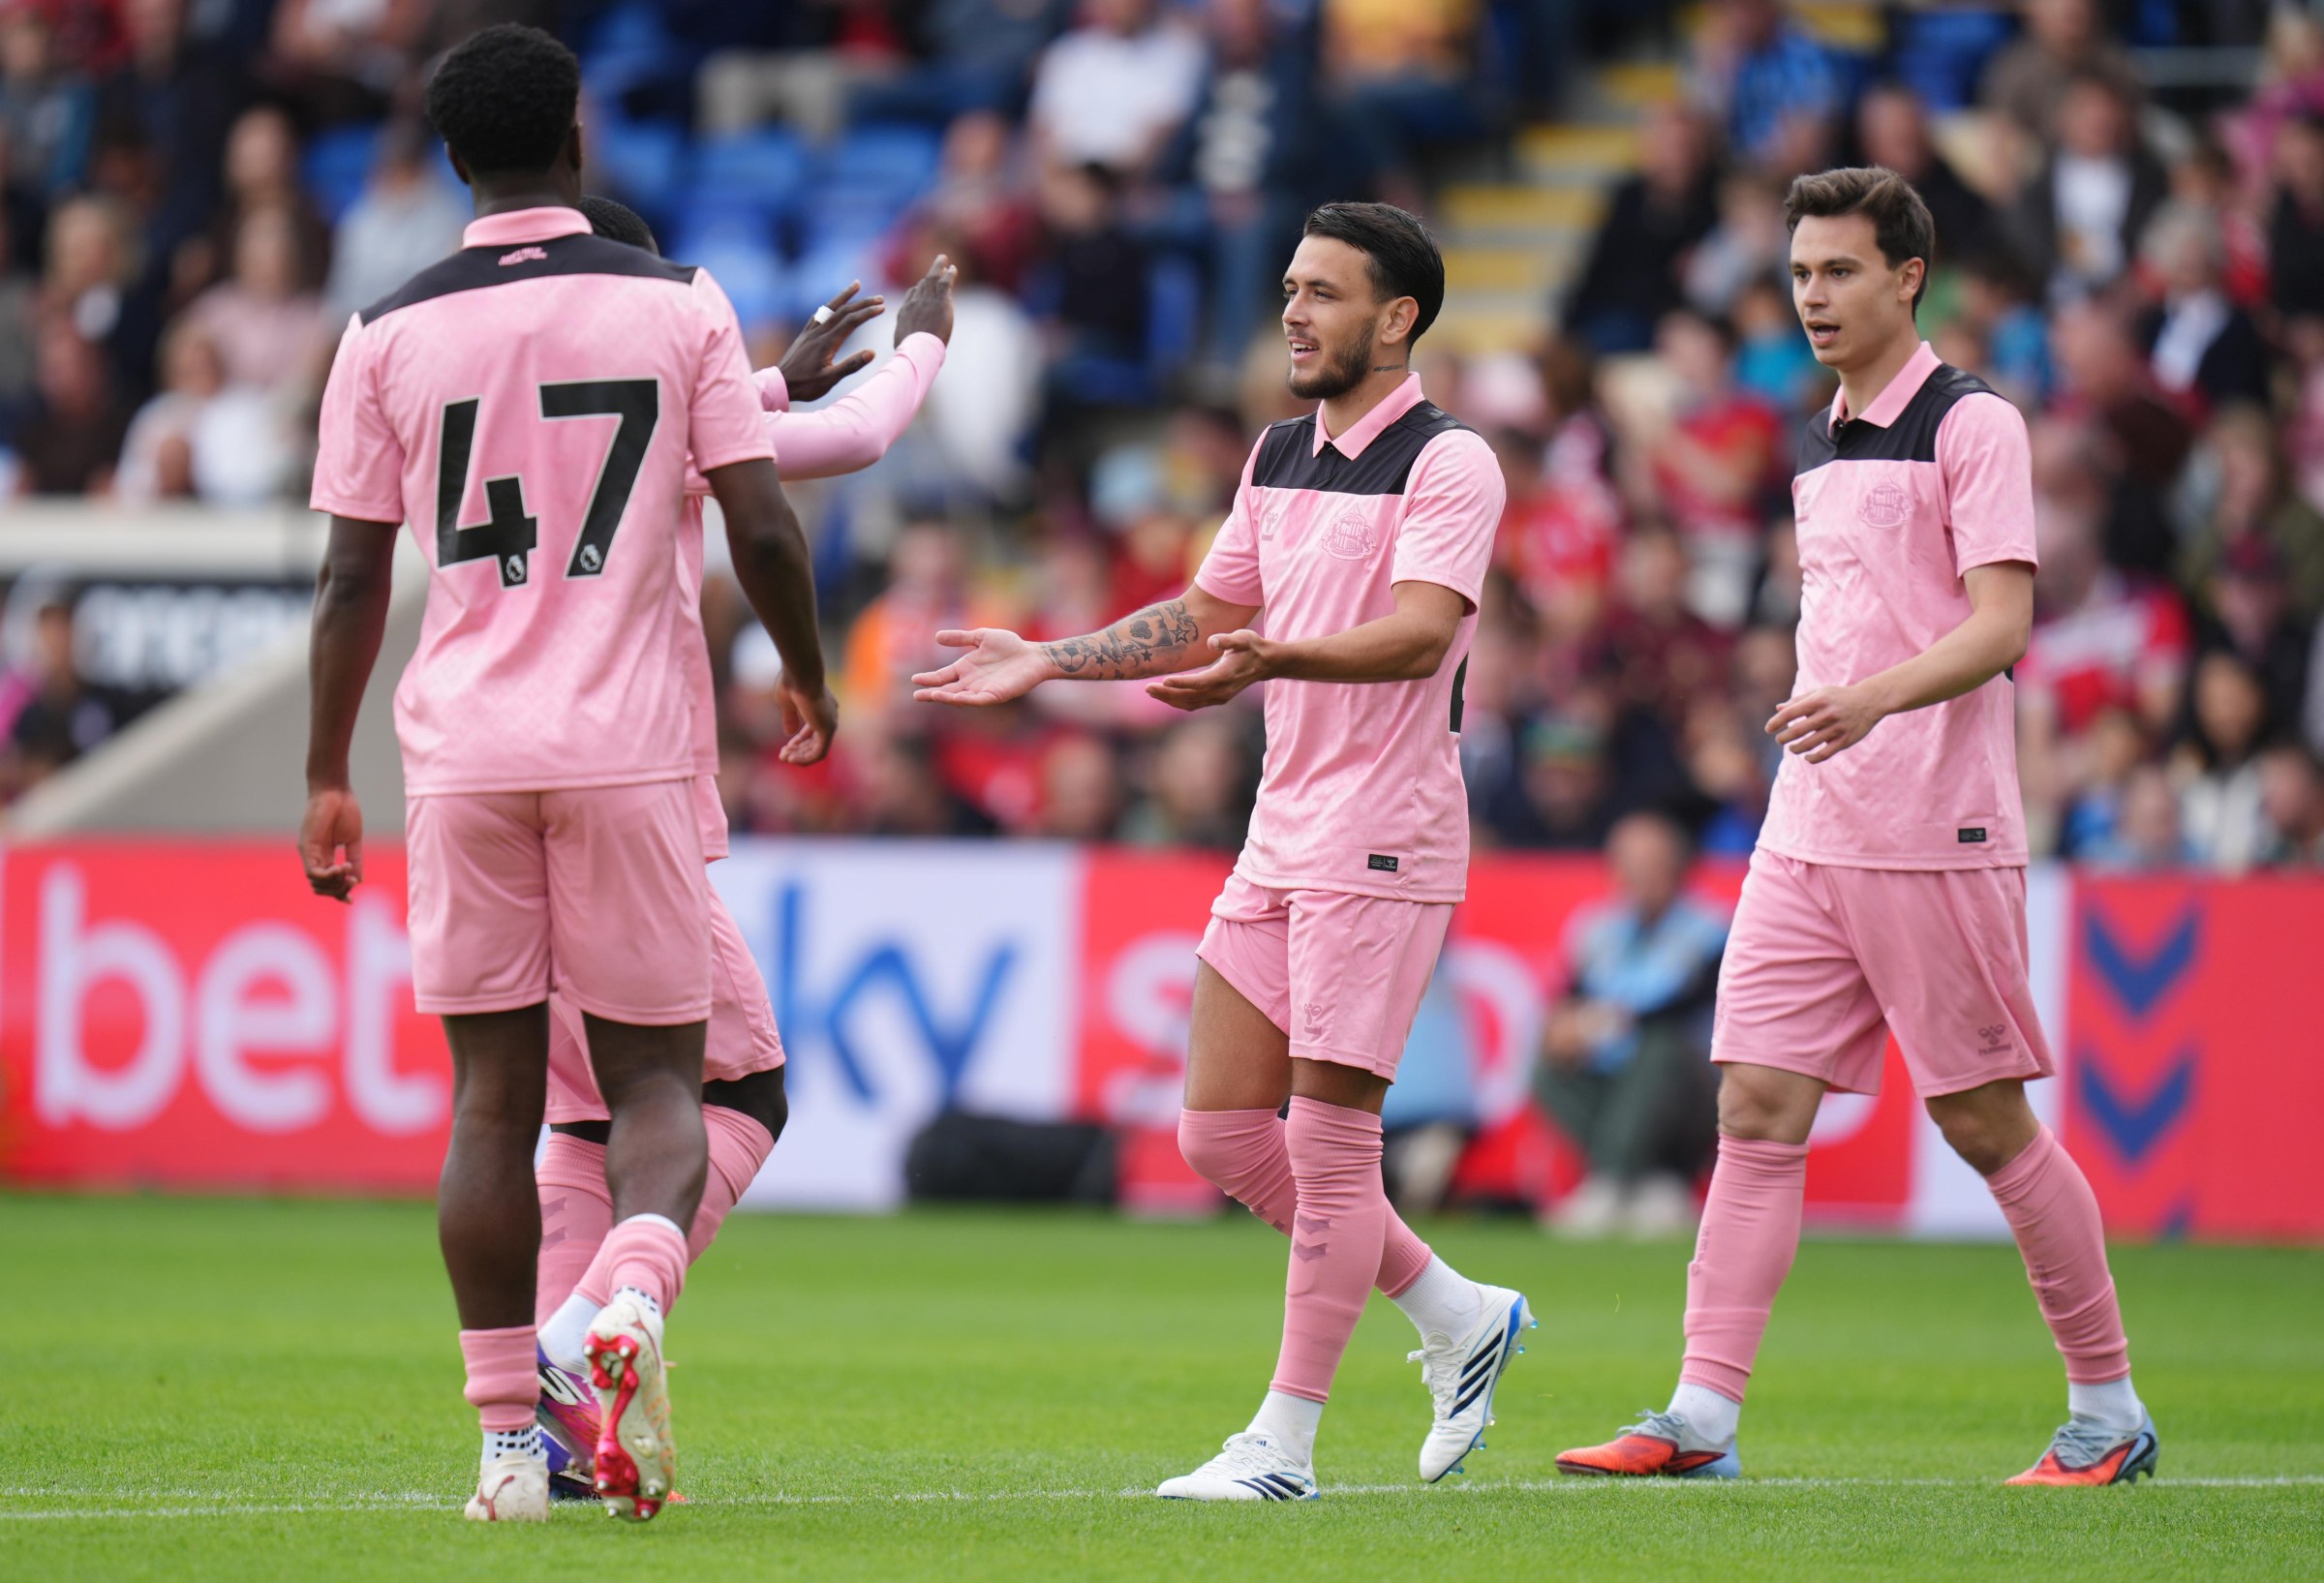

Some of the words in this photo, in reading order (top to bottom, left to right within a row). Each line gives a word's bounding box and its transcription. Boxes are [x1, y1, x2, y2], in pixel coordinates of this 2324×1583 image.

[435, 376, 662, 591] 47
[36, 862, 450, 1133] bet
[775, 879, 1017, 1115] ky
